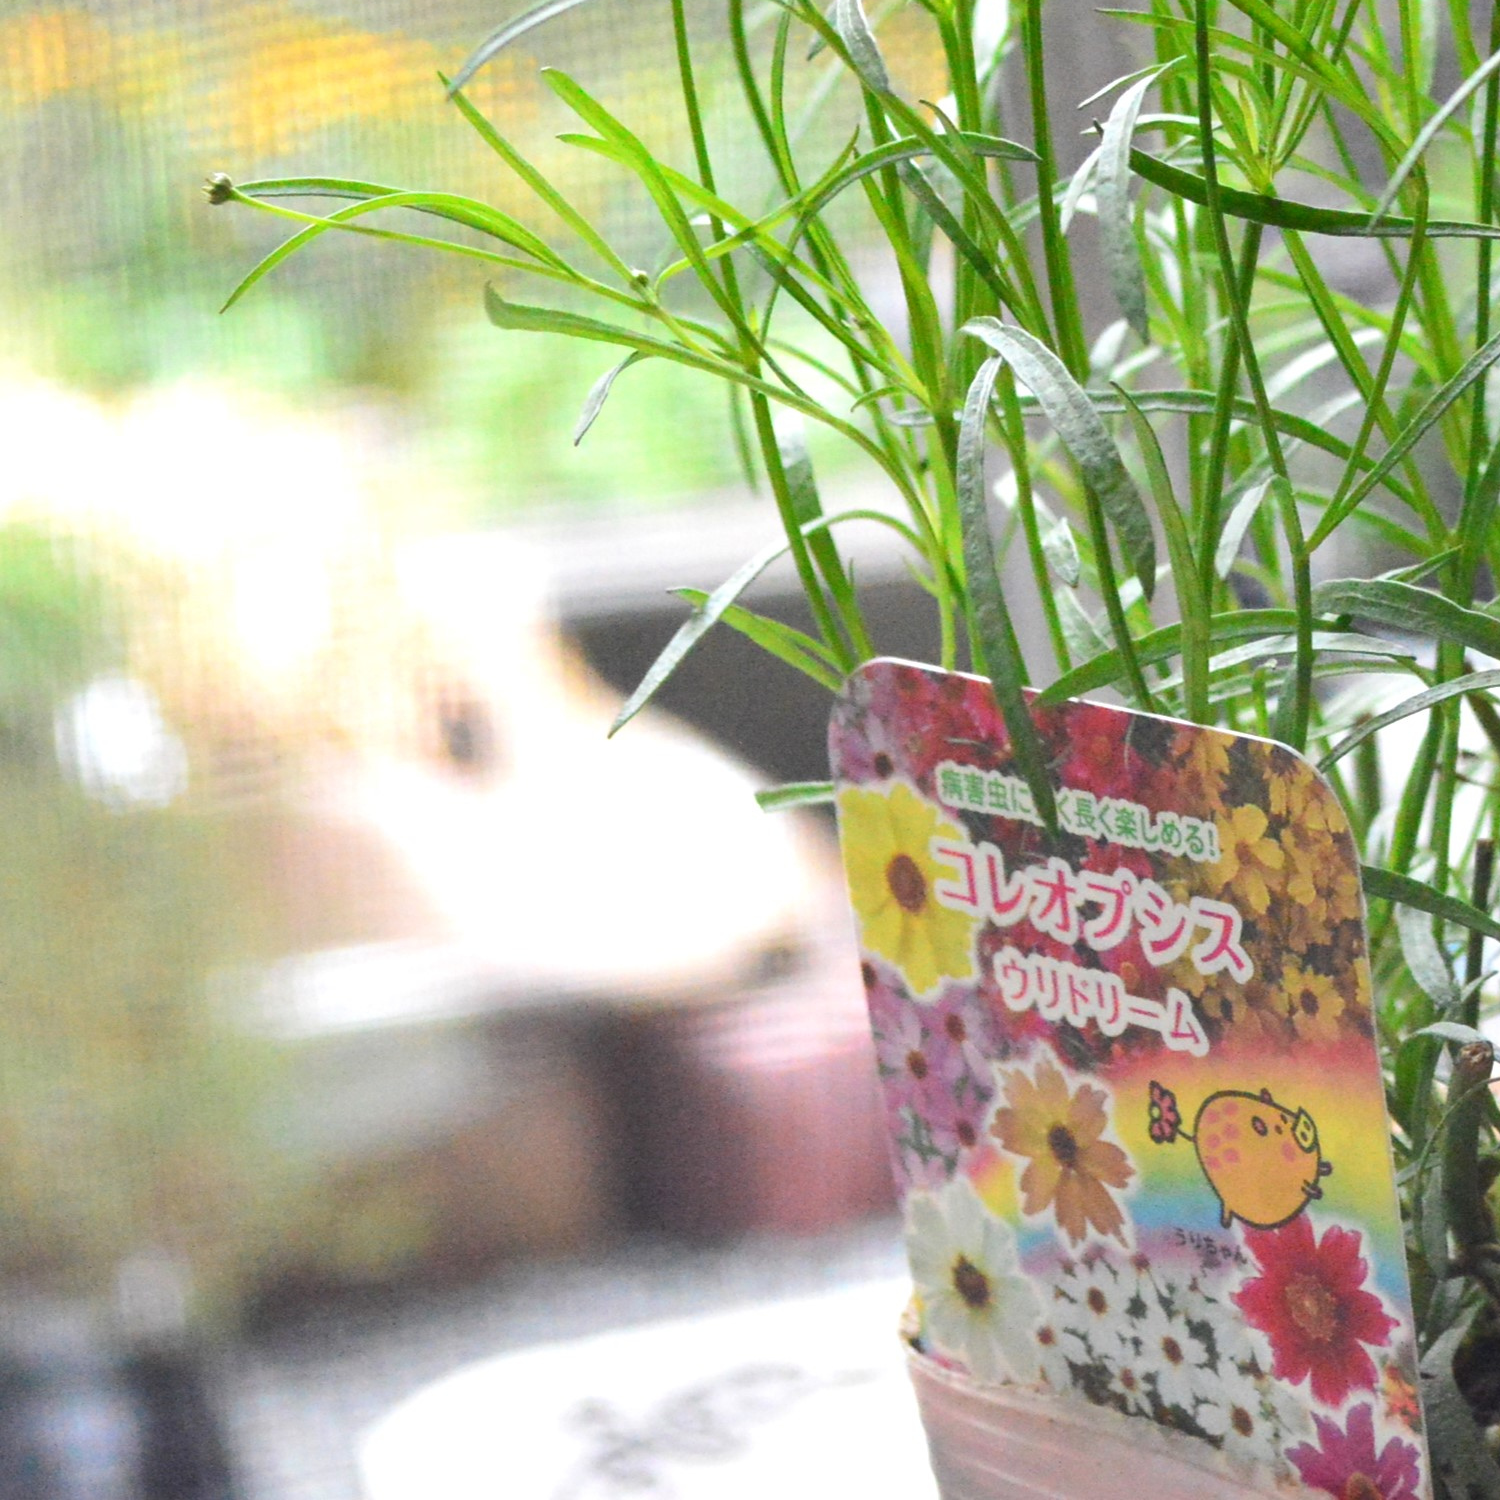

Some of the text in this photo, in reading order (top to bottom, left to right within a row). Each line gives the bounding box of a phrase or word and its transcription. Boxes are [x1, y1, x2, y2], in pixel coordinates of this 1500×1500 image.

[939, 765, 1218, 859] 病害虫にく長く楽しめる!
[936, 844, 1248, 975] コレオプシス
[1000, 957, 1203, 1047] ウリドリーム
